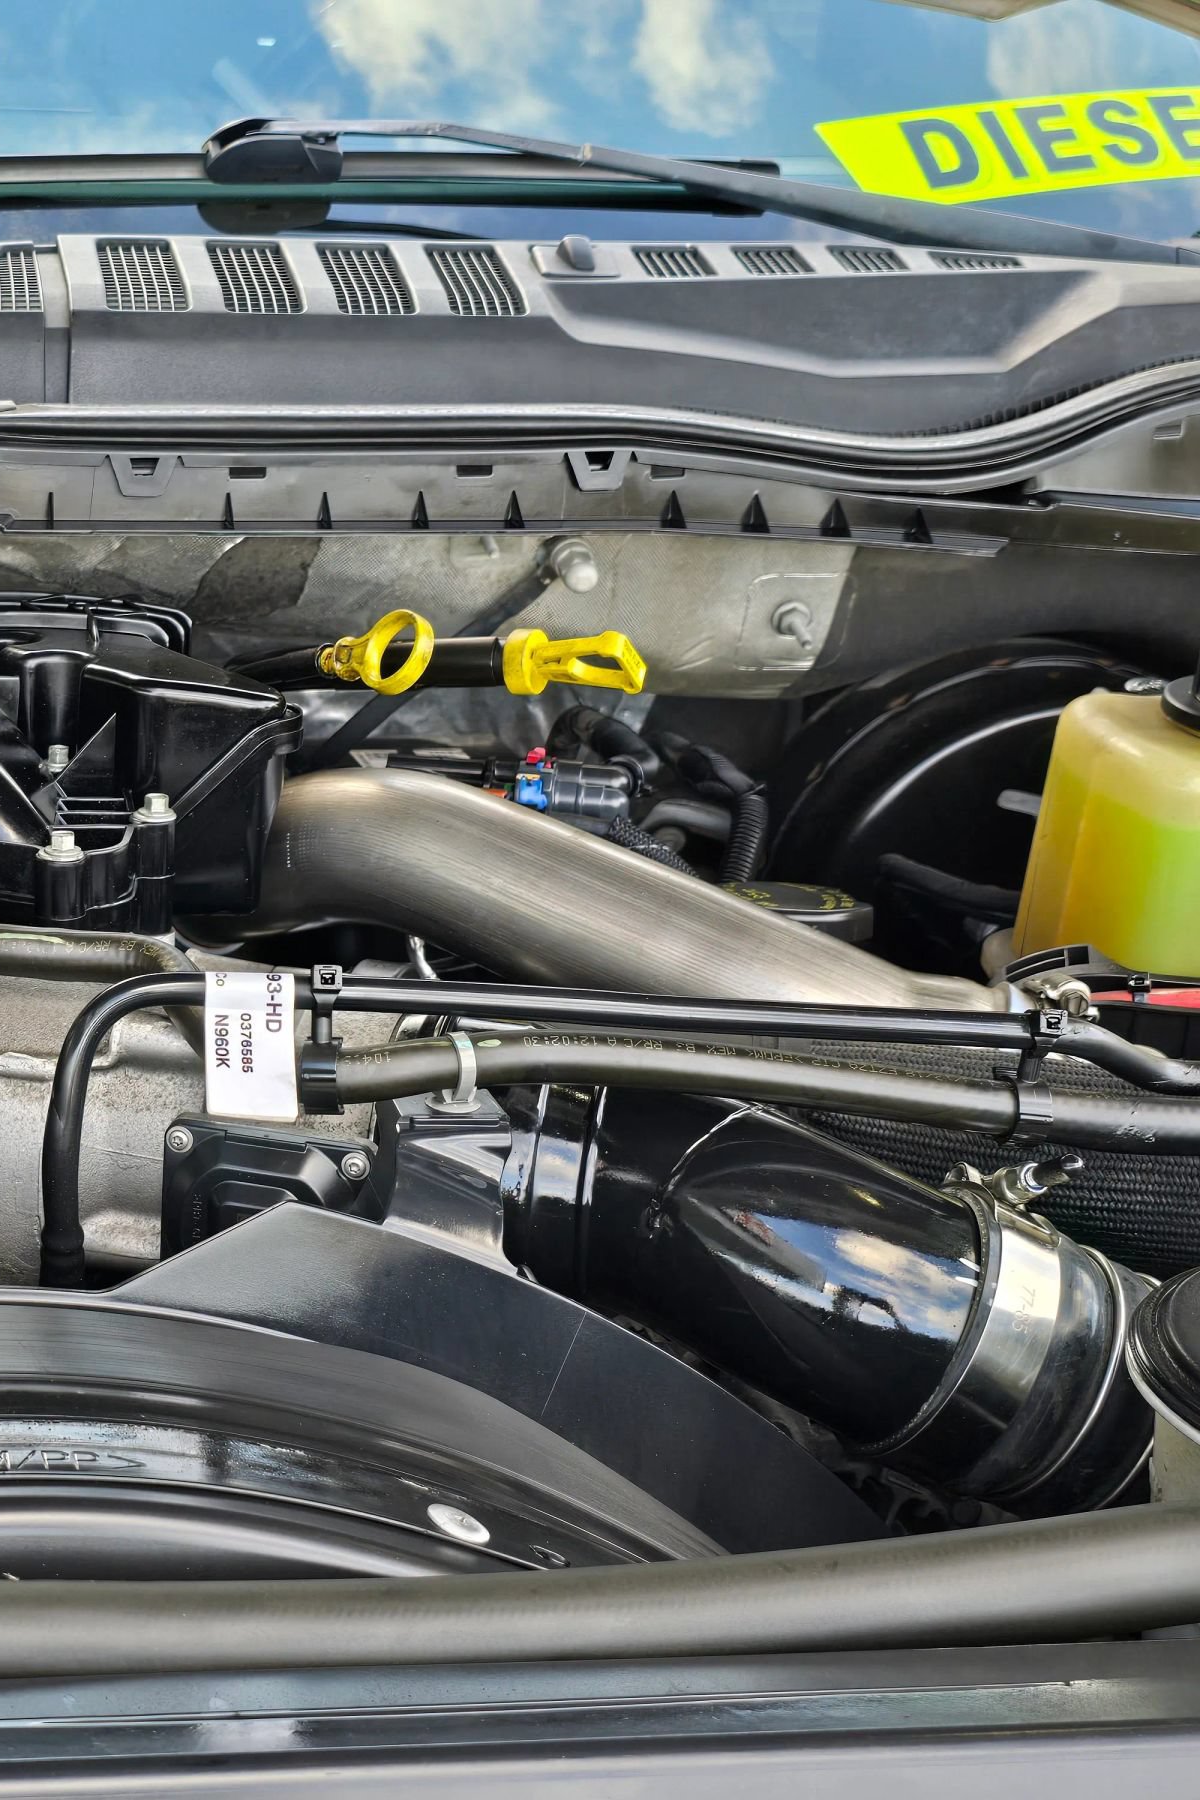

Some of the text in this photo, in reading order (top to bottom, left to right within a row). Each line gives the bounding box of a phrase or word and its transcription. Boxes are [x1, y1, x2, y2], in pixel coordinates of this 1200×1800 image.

[265, 974, 283, 1033] 93-HD
[214, 1014, 231, 1069] N960K
[240, 1013, 254, 1073] 0376585
[523, 1035, 598, 1047] 12:02:30
[607, 1036, 617, 1047] A
[623, 1038, 663, 1051] RR/C
